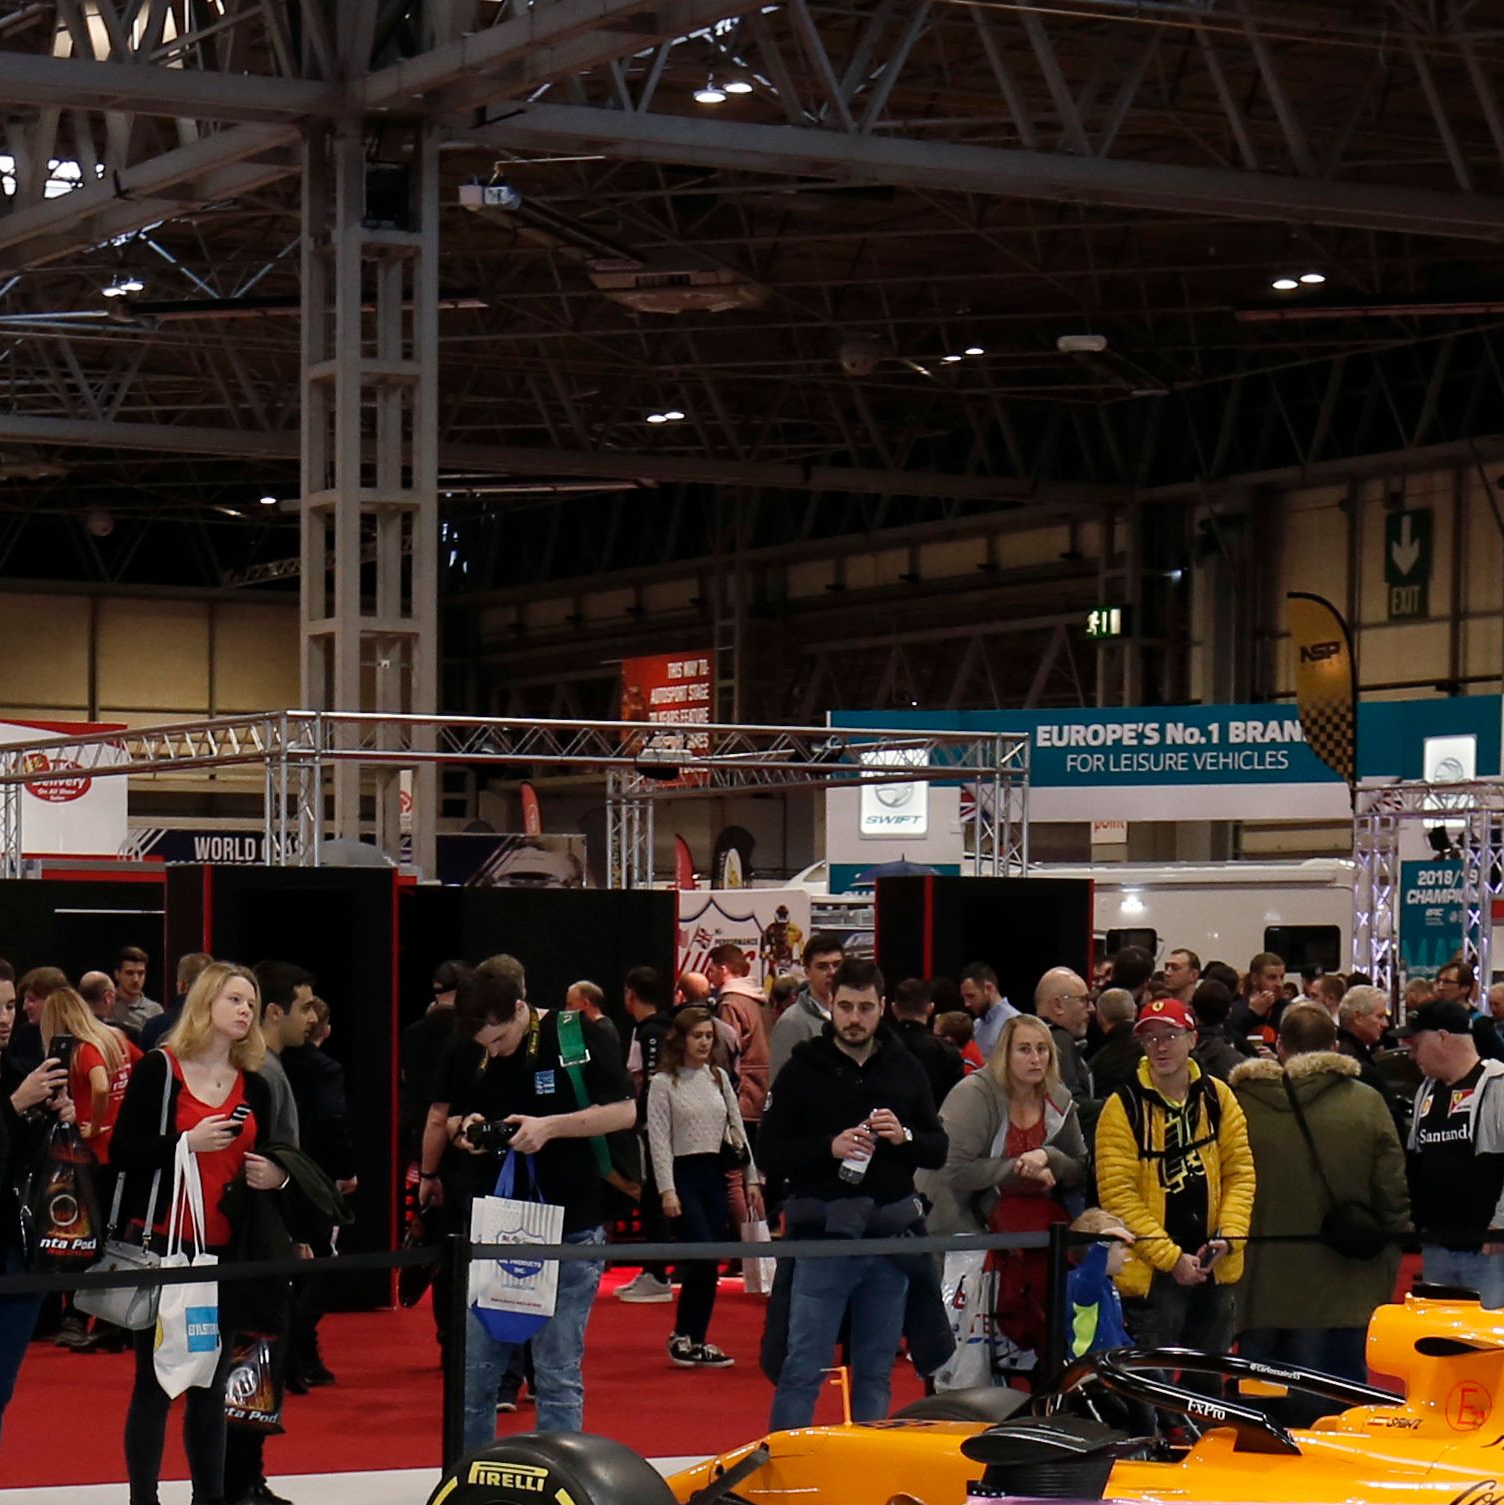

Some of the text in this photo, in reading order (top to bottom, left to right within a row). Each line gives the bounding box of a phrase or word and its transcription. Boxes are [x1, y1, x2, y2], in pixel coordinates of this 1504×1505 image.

[1392, 586, 1421, 614] EXIT
[1037, 719, 1304, 749] EUROPE'S No.1 BRAN
[1066, 750, 1289, 772] FOR LEISURE VEHICLES
[864, 814, 925, 826] SWIFT
[194, 837, 256, 861] WORLD
[1417, 868, 1479, 888] 2018/9
[1419, 1127, 1474, 1144] Santand
[1186, 1398, 1227, 1422] FxPro
[468, 1460, 549, 1493] PIRELLI
